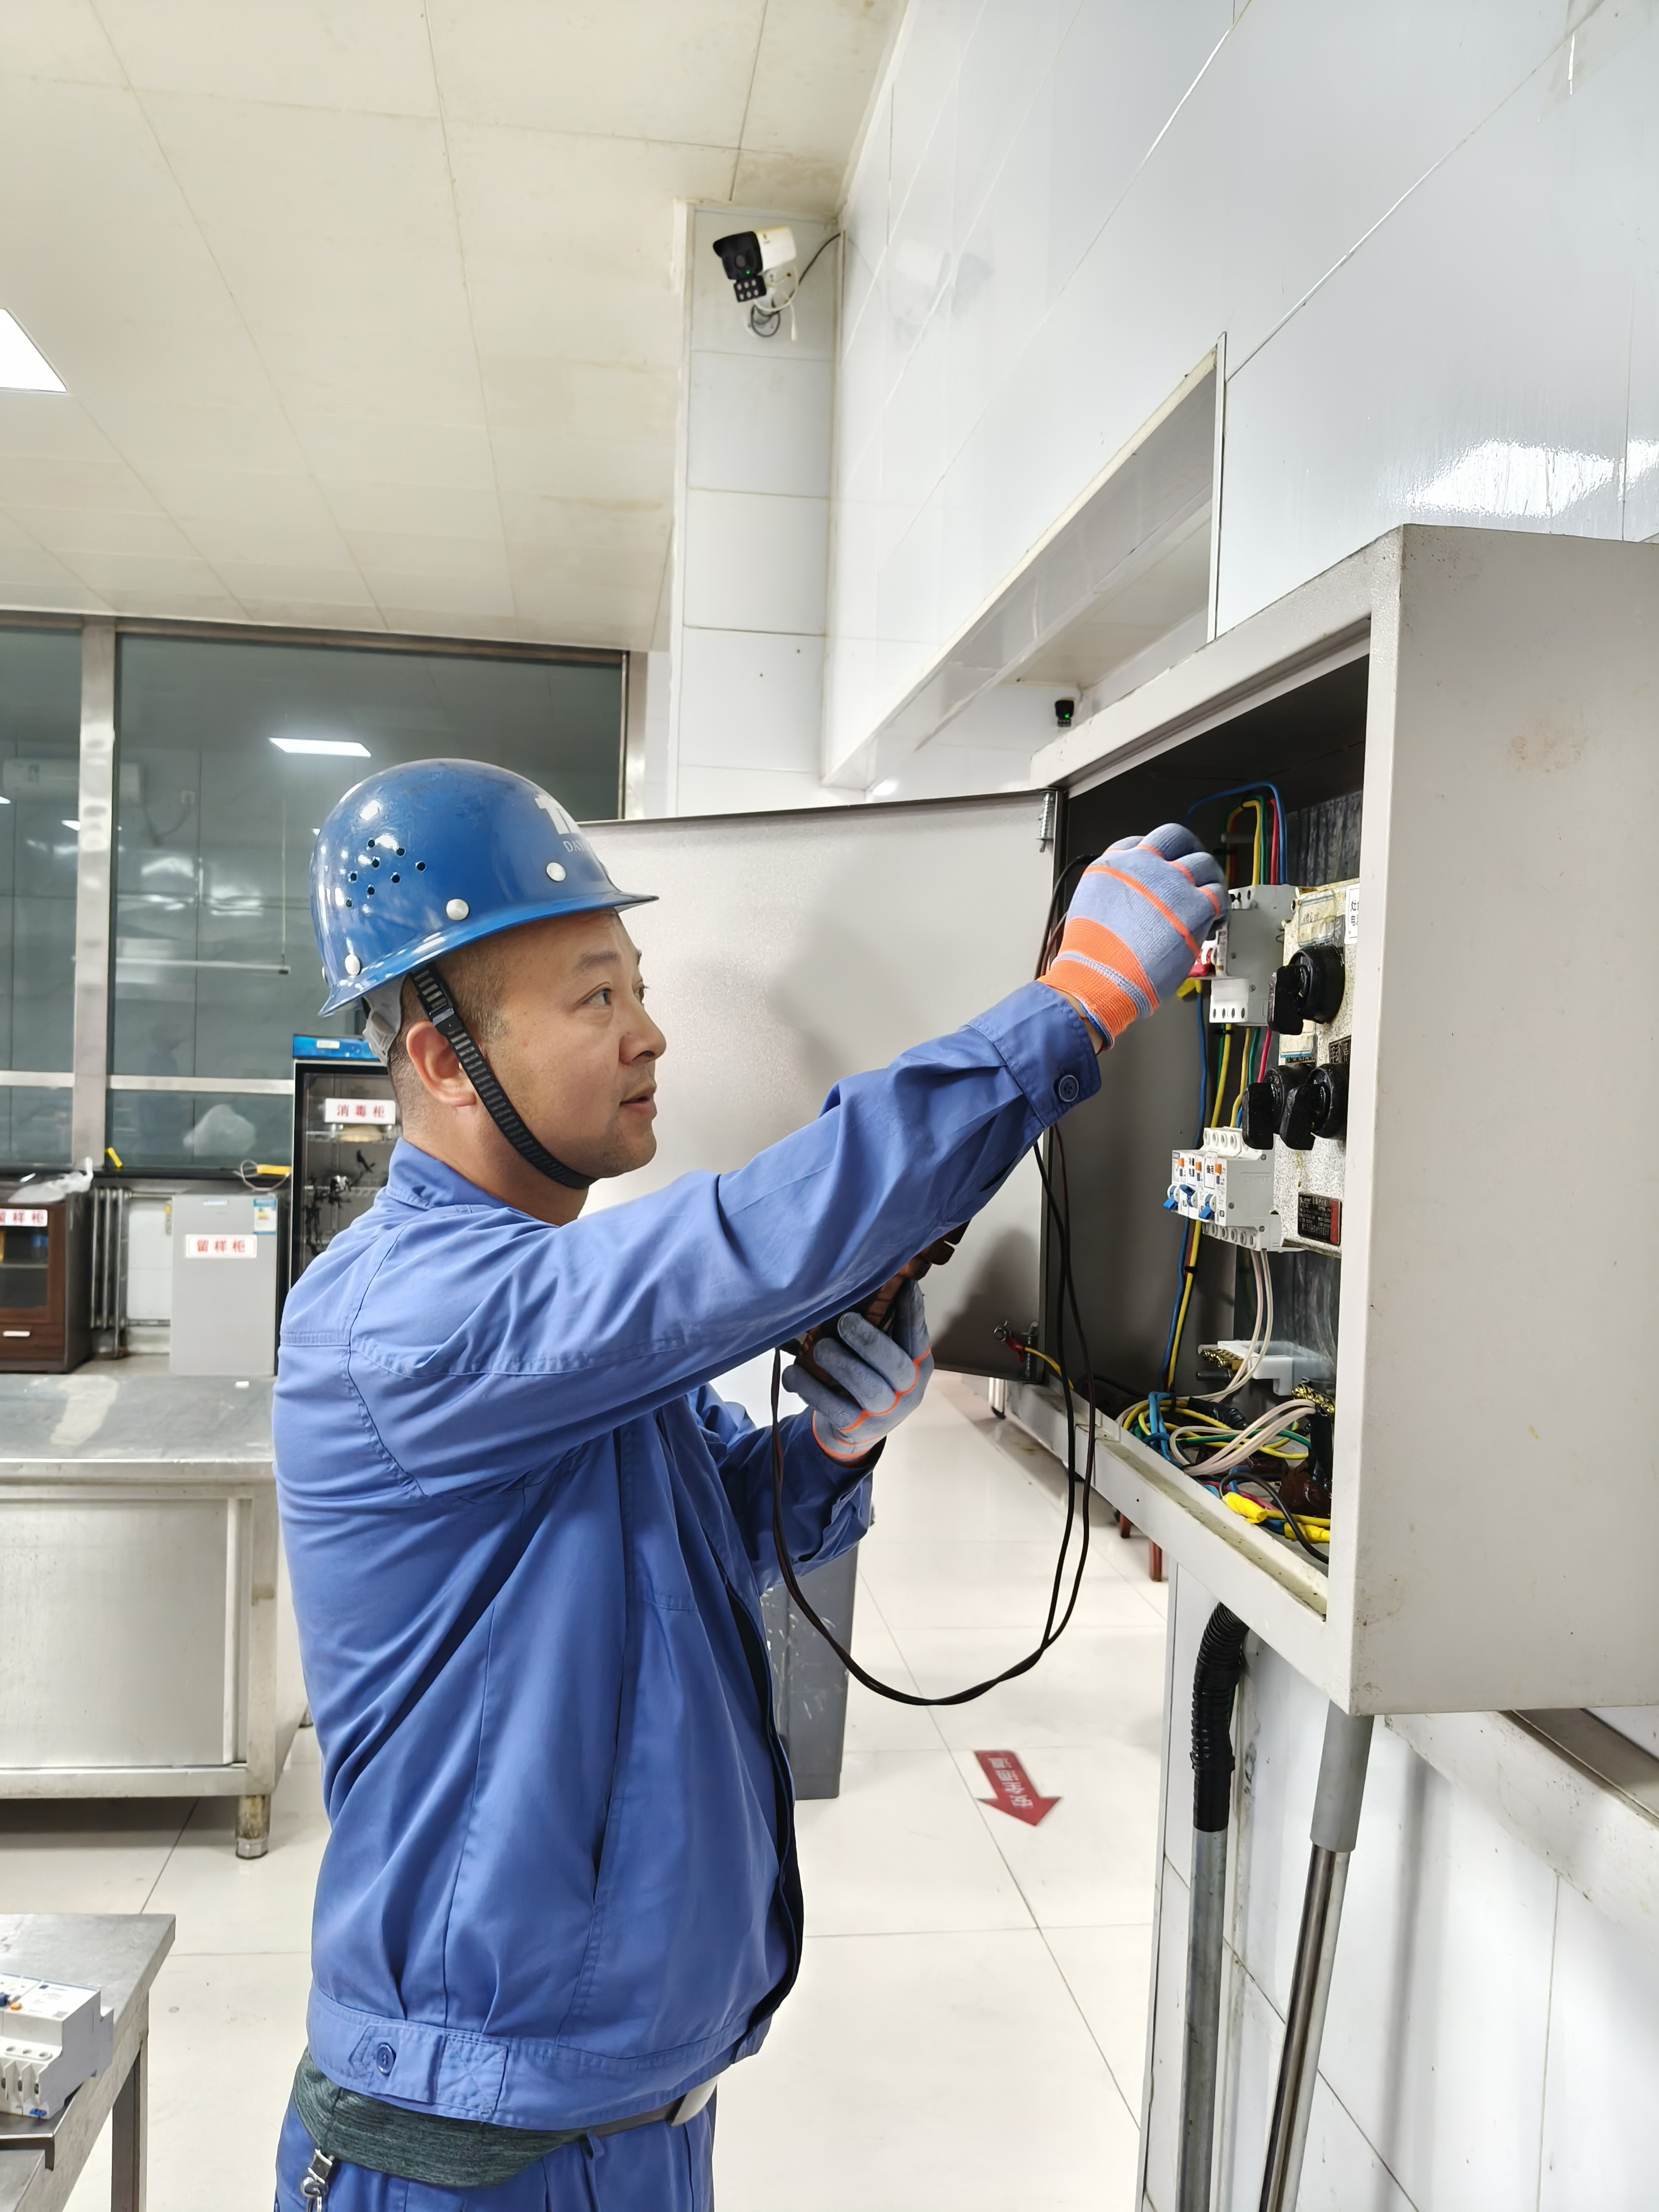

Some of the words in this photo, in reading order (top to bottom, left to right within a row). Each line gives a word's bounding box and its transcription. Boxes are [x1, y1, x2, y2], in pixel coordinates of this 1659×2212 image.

[336, 1104, 385, 1117] 消毒柜
[197, 1239, 246, 1253] 留样柜
